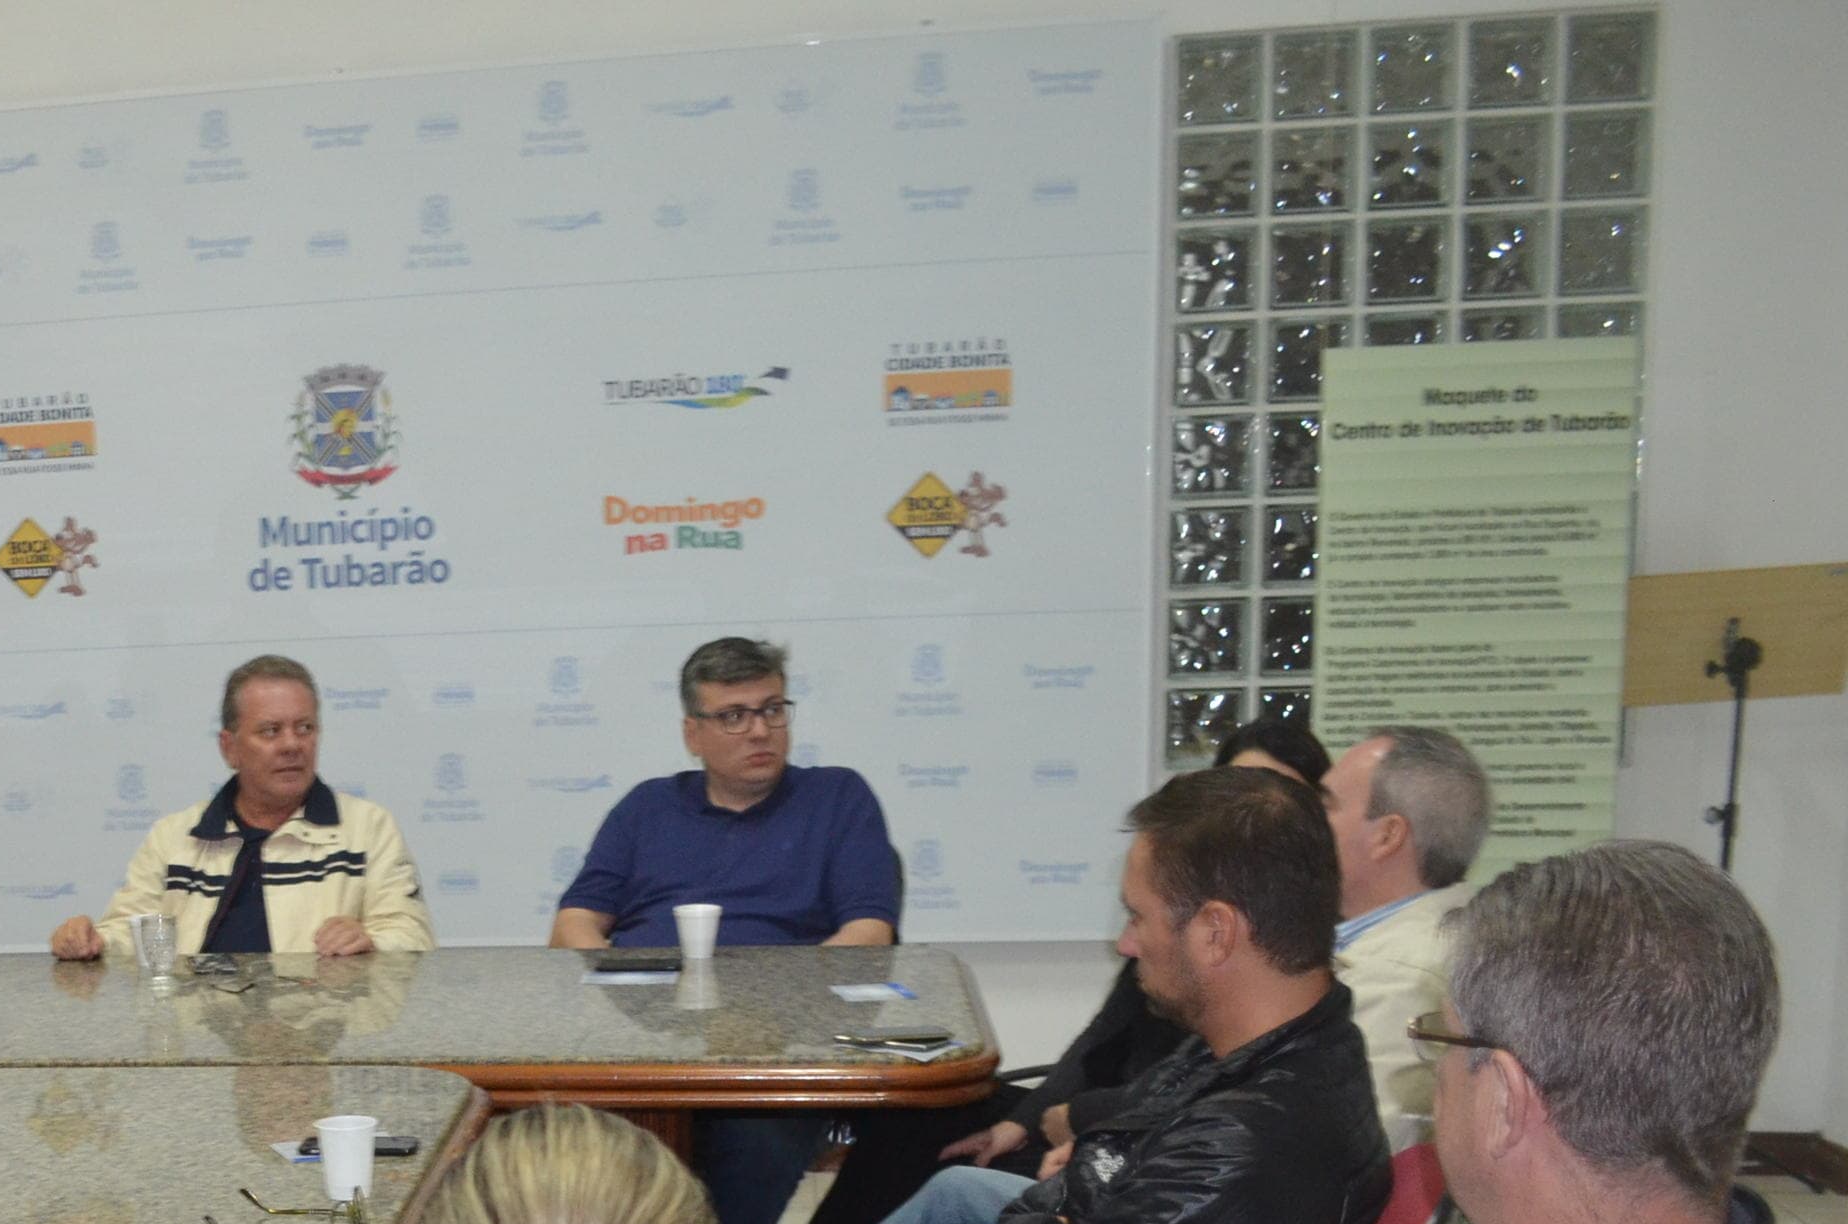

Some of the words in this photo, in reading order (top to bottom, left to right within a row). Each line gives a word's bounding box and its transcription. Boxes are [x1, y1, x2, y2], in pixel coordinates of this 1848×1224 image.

[603, 373, 701, 399] TUBARÃO
[1330, 421, 1391, 440] Centro
[1398, 420, 1423, 437] de
[1428, 416, 1515, 440] Inovação
[1521, 417, 1547, 433] de
[1550, 412, 1631, 431] Tubarão
[603, 496, 766, 528] Domingo
[259, 507, 436, 550] Município
[624, 533, 669, 555] na
[675, 525, 744, 550] Rua
[249, 558, 292, 591] de
[299, 551, 451, 589] Tubarão
